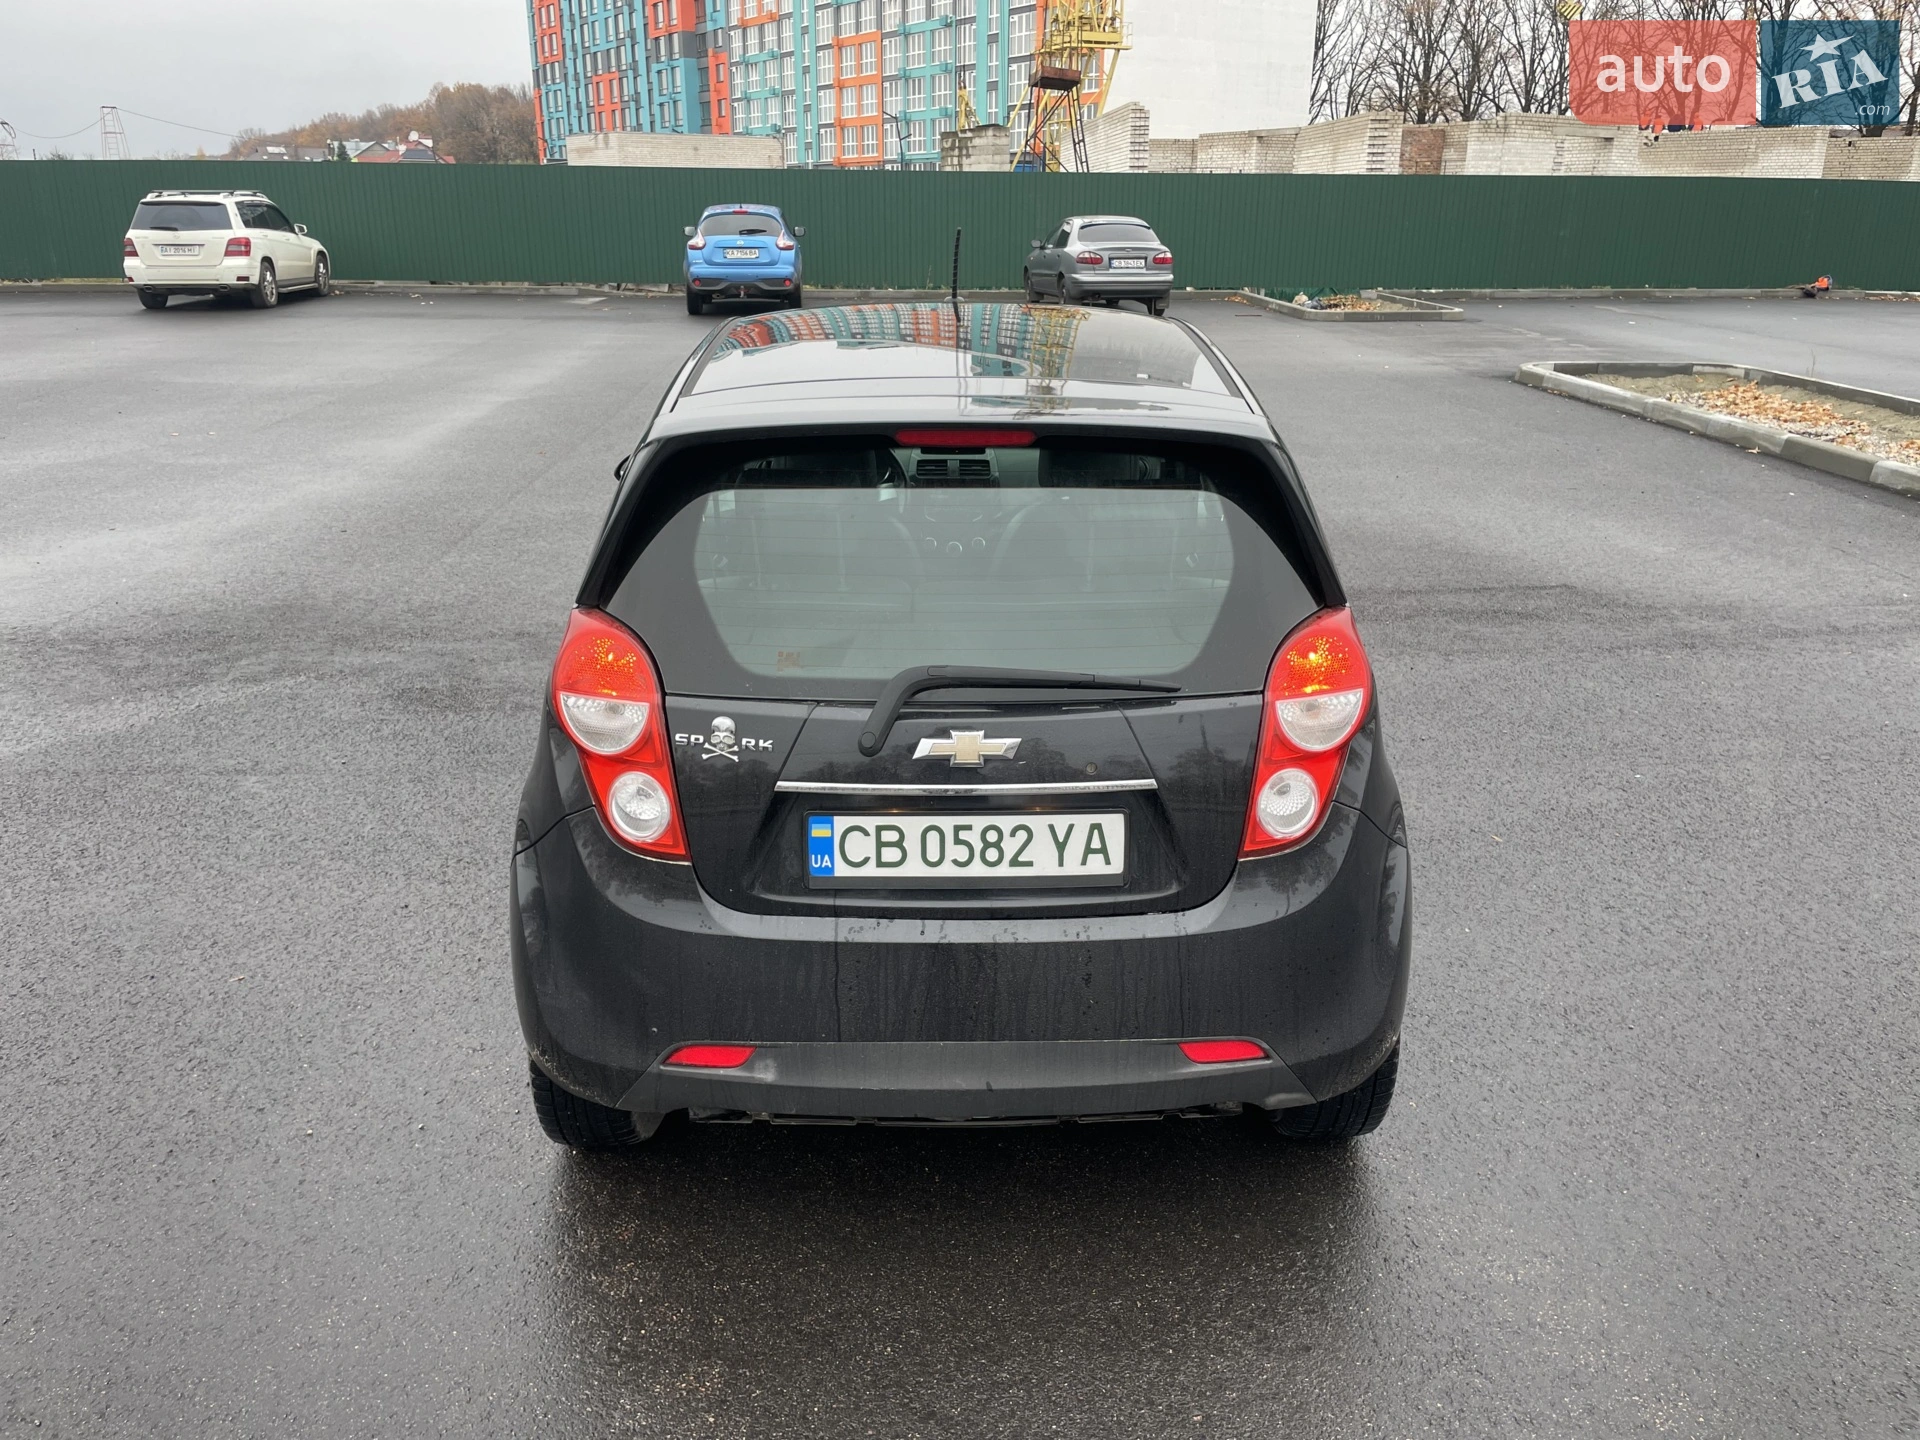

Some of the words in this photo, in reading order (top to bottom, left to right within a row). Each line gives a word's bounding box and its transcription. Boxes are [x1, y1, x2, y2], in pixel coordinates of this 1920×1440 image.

[839, 824, 908, 868] CB
[920, 823, 1034, 868] 0582
[1047, 822, 1112, 867] YA
[811, 854, 832, 869] UA
